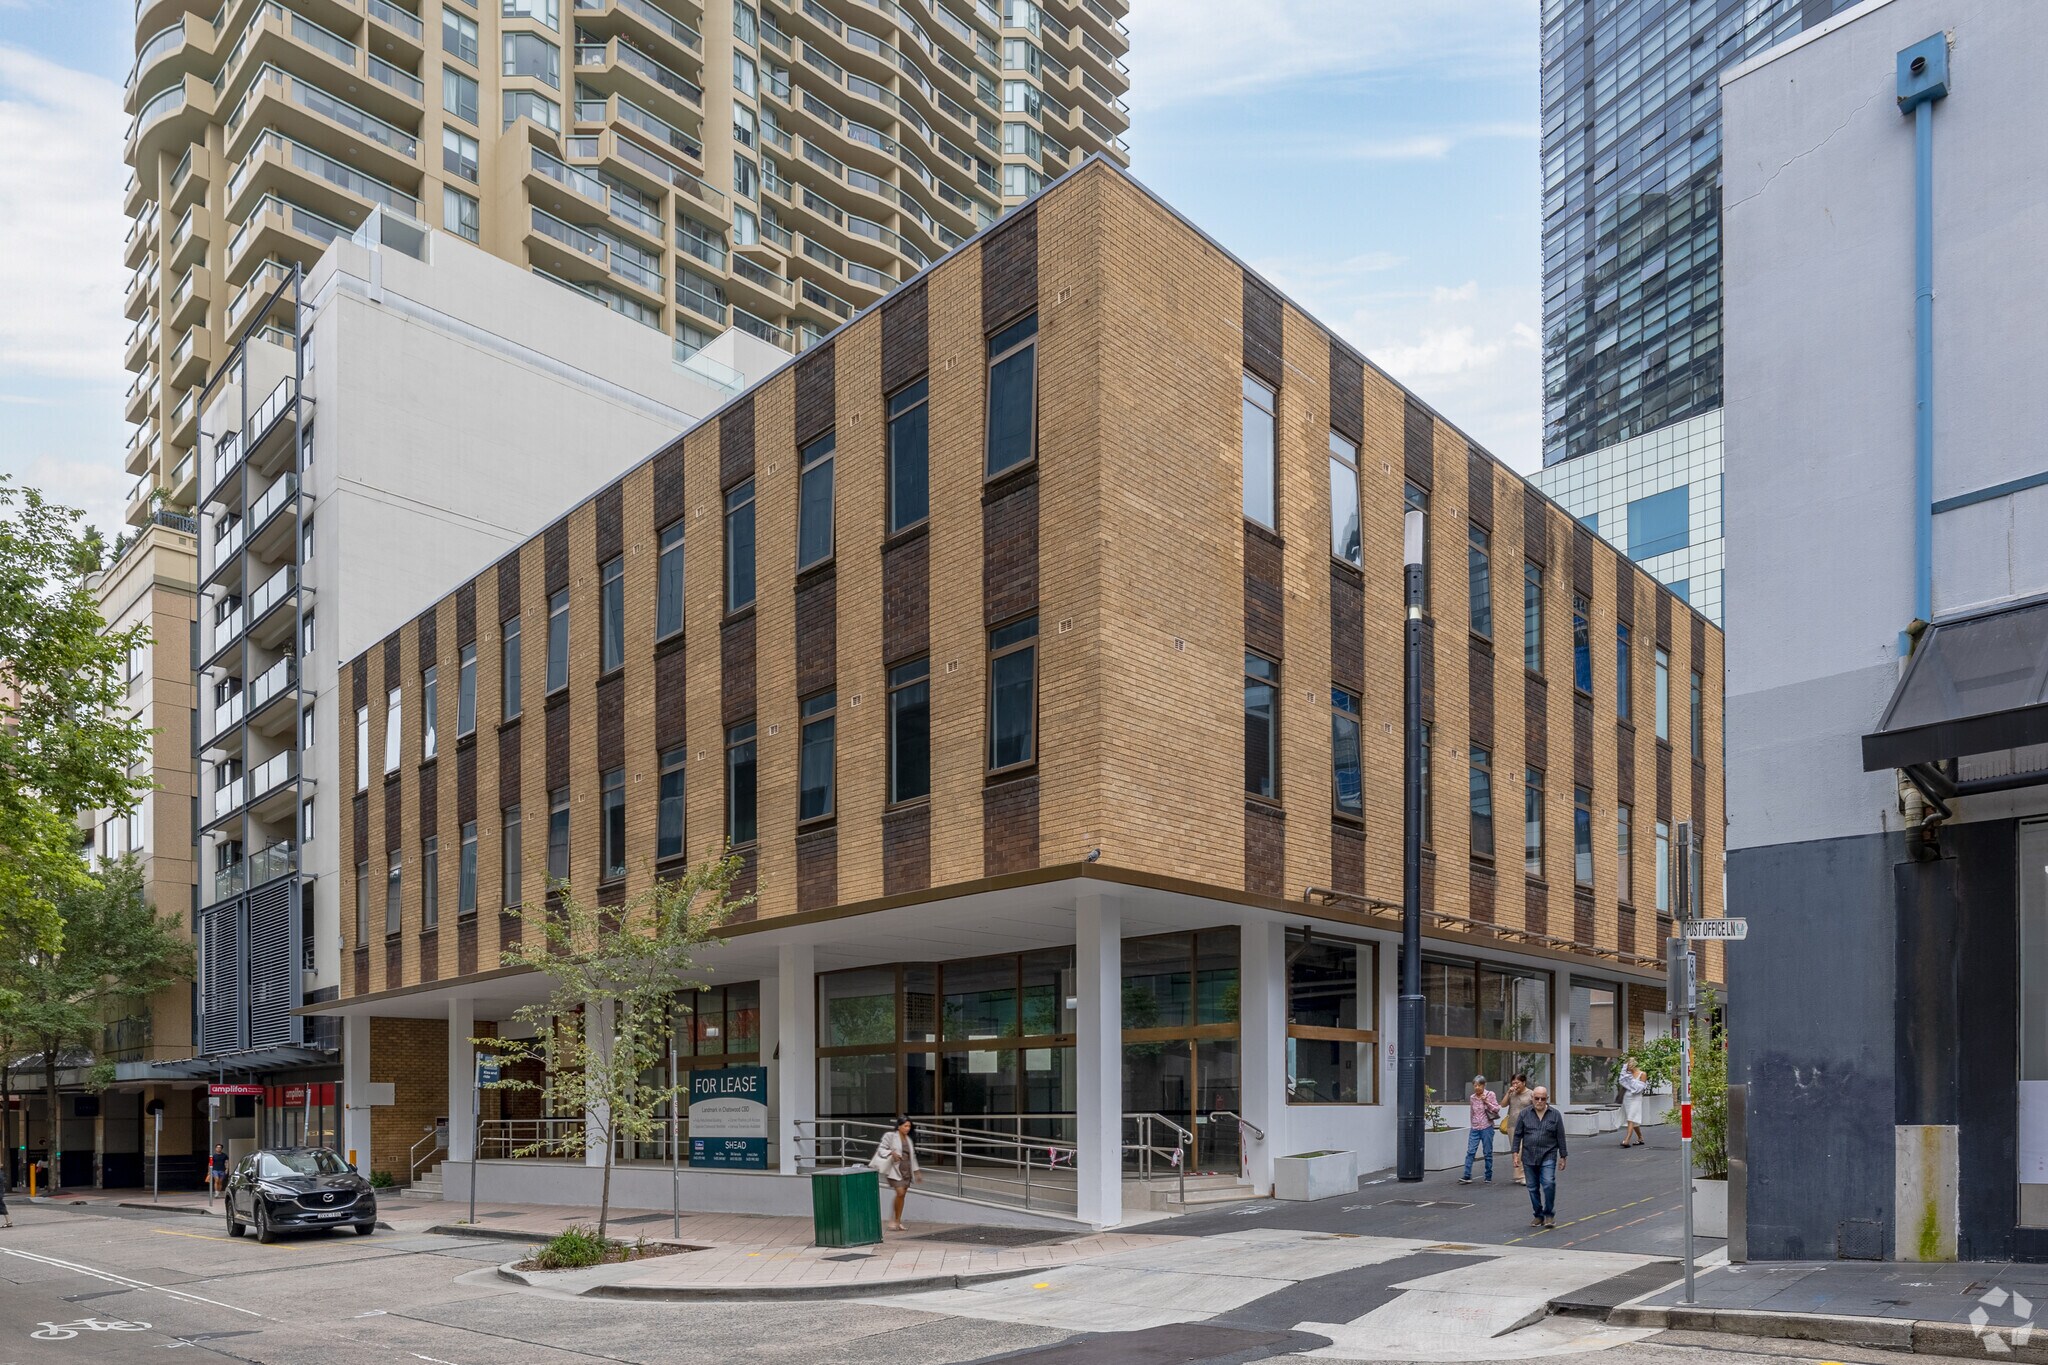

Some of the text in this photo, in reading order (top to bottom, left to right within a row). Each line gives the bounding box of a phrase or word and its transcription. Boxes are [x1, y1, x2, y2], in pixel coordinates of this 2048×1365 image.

[1686, 921, 1735, 936] POST OFFICE LN
[211, 1085, 248, 1094] amplifon
[695, 1076, 757, 1094] FOR LEASE
[286, 1087, 305, 1100] amplifon
[724, 1141, 747, 1150] SHEAD
